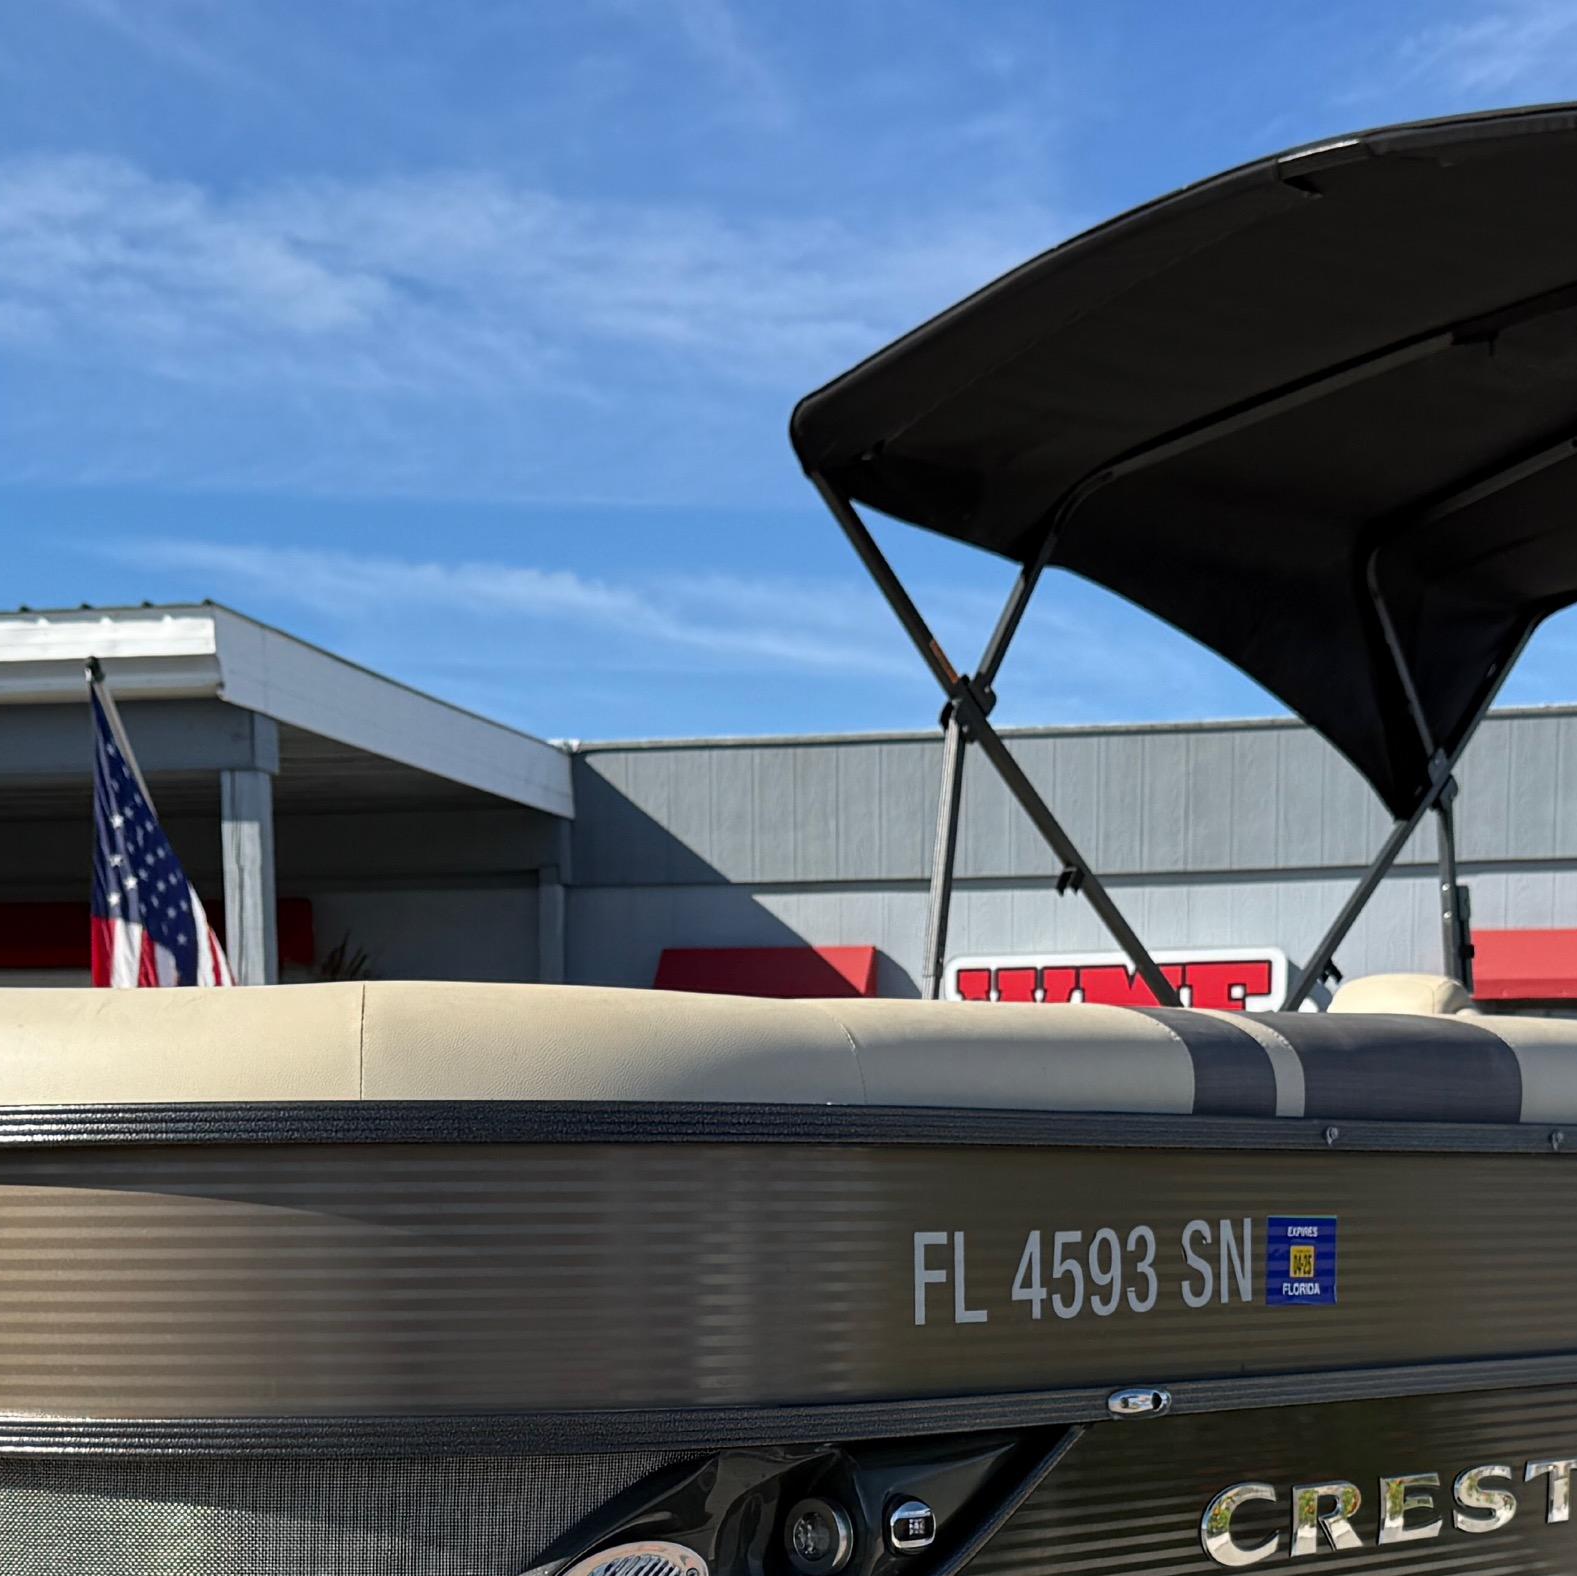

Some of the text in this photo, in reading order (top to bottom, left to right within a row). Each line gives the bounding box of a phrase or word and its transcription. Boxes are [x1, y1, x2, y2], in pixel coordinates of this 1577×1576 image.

[1287, 1226, 1319, 1238] EXPIRES
[913, 1217, 1253, 1326] FL 4593 SN
[1282, 1282, 1321, 1296] FLORIDA
